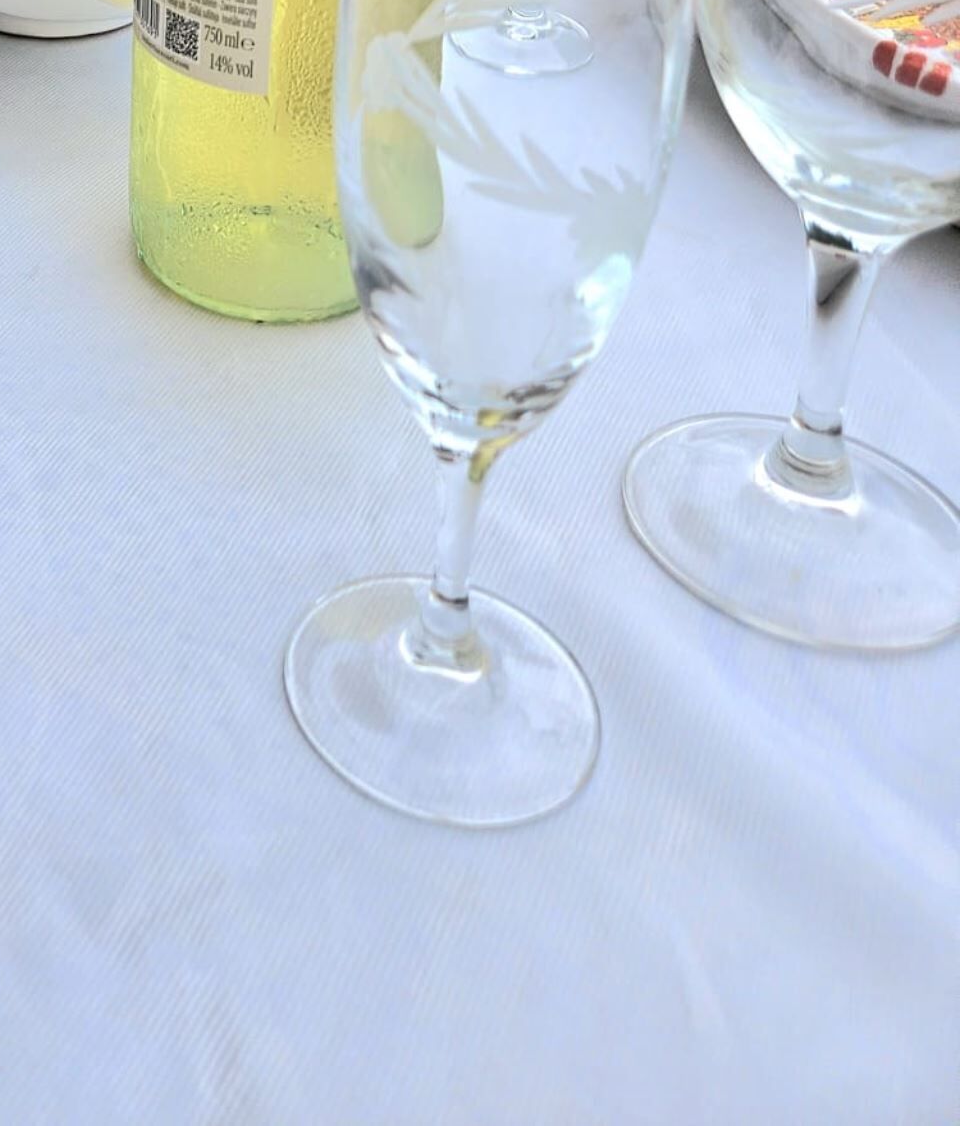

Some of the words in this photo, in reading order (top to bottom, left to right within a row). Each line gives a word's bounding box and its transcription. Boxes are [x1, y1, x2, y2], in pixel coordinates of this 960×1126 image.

[204, 24, 224, 45] 750
[210, 52, 234, 76] 14%
[235, 59, 254, 79] vol
